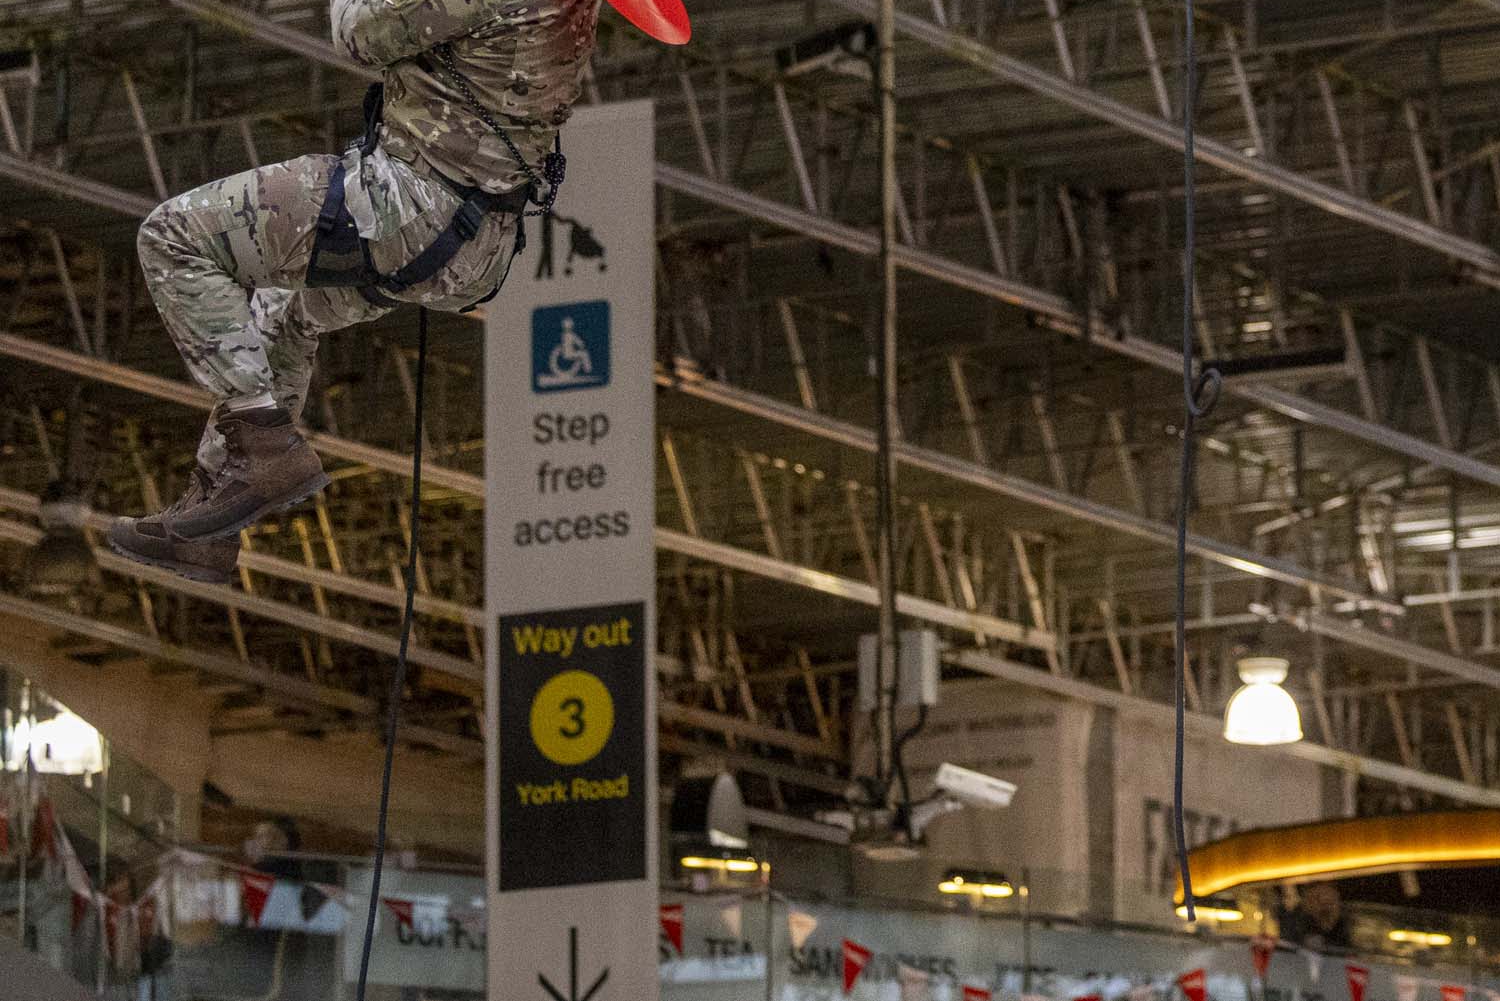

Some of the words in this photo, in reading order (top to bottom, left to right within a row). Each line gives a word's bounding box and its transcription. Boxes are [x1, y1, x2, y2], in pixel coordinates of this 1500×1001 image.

[533, 411, 609, 446] Step
[537, 459, 607, 493] free
[514, 510, 632, 548] access
[512, 624, 577, 659] Way
[582, 618, 632, 649] out
[559, 698, 585, 739] 3
[515, 780, 569, 806] York
[571, 773, 630, 800] Road
